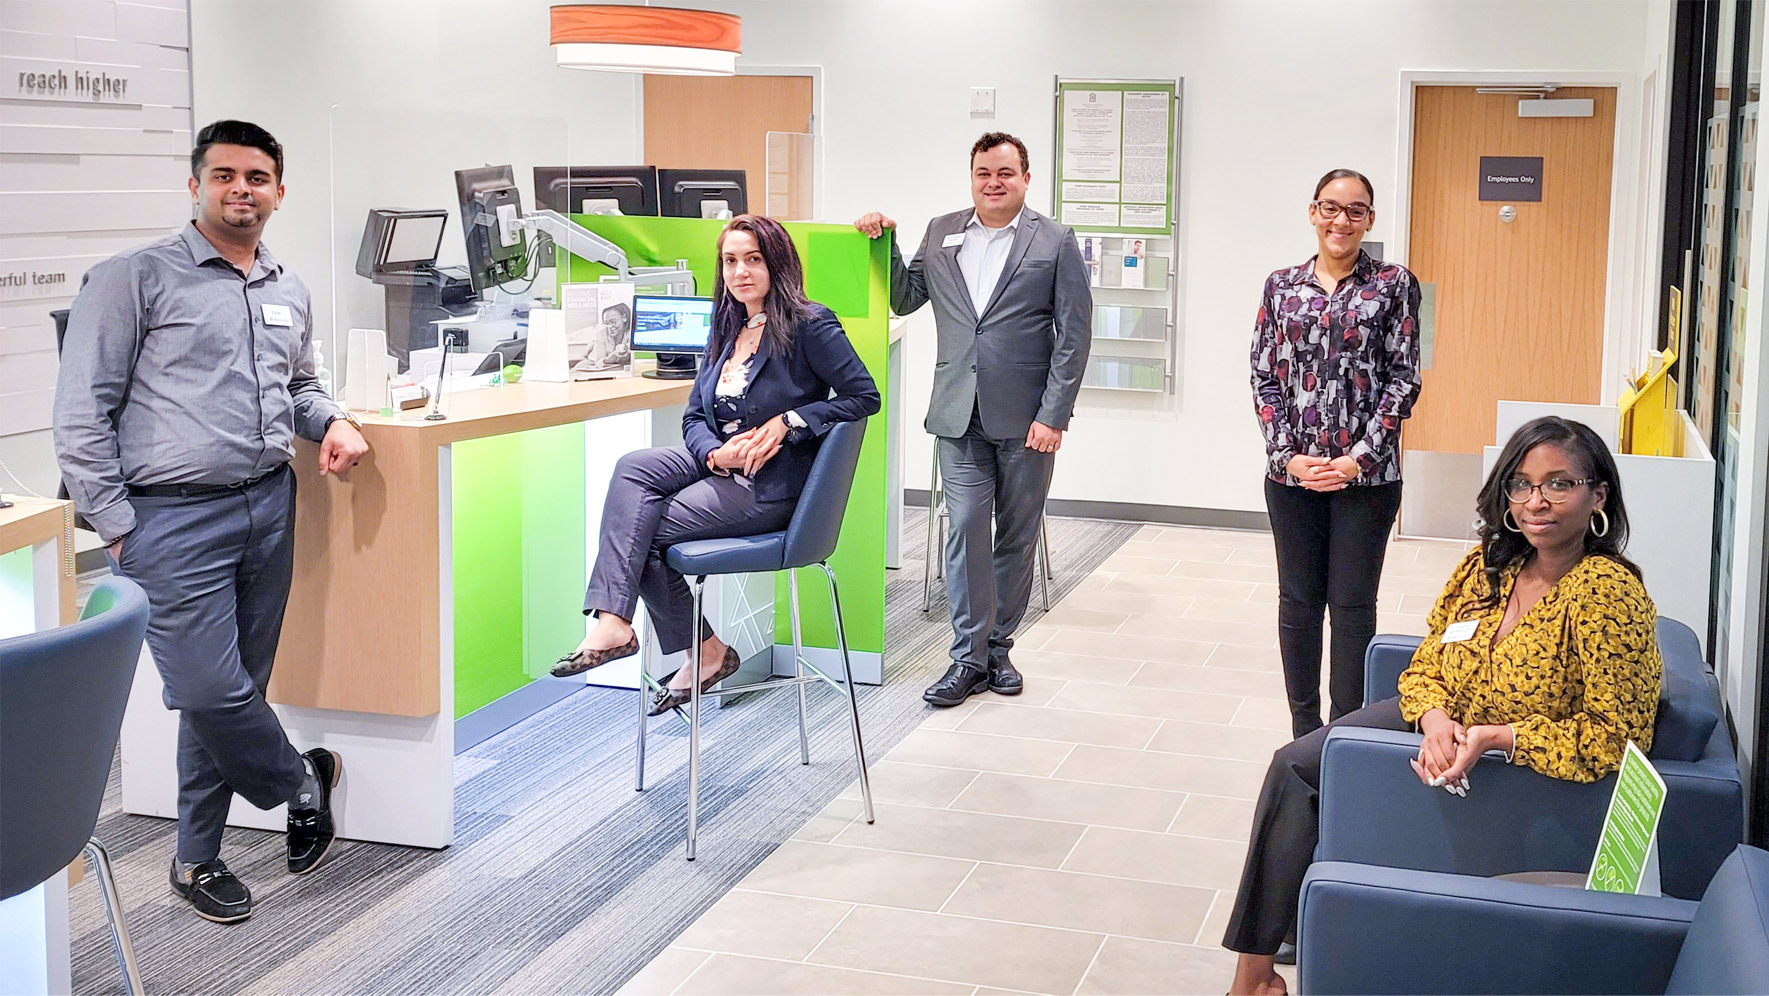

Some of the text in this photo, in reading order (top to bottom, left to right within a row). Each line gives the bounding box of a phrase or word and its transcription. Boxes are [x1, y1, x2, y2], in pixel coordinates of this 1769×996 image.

[19, 69, 128, 96] reach higher
[1487, 175, 1535, 184] Employees Only
[32, 271, 65, 285] team
